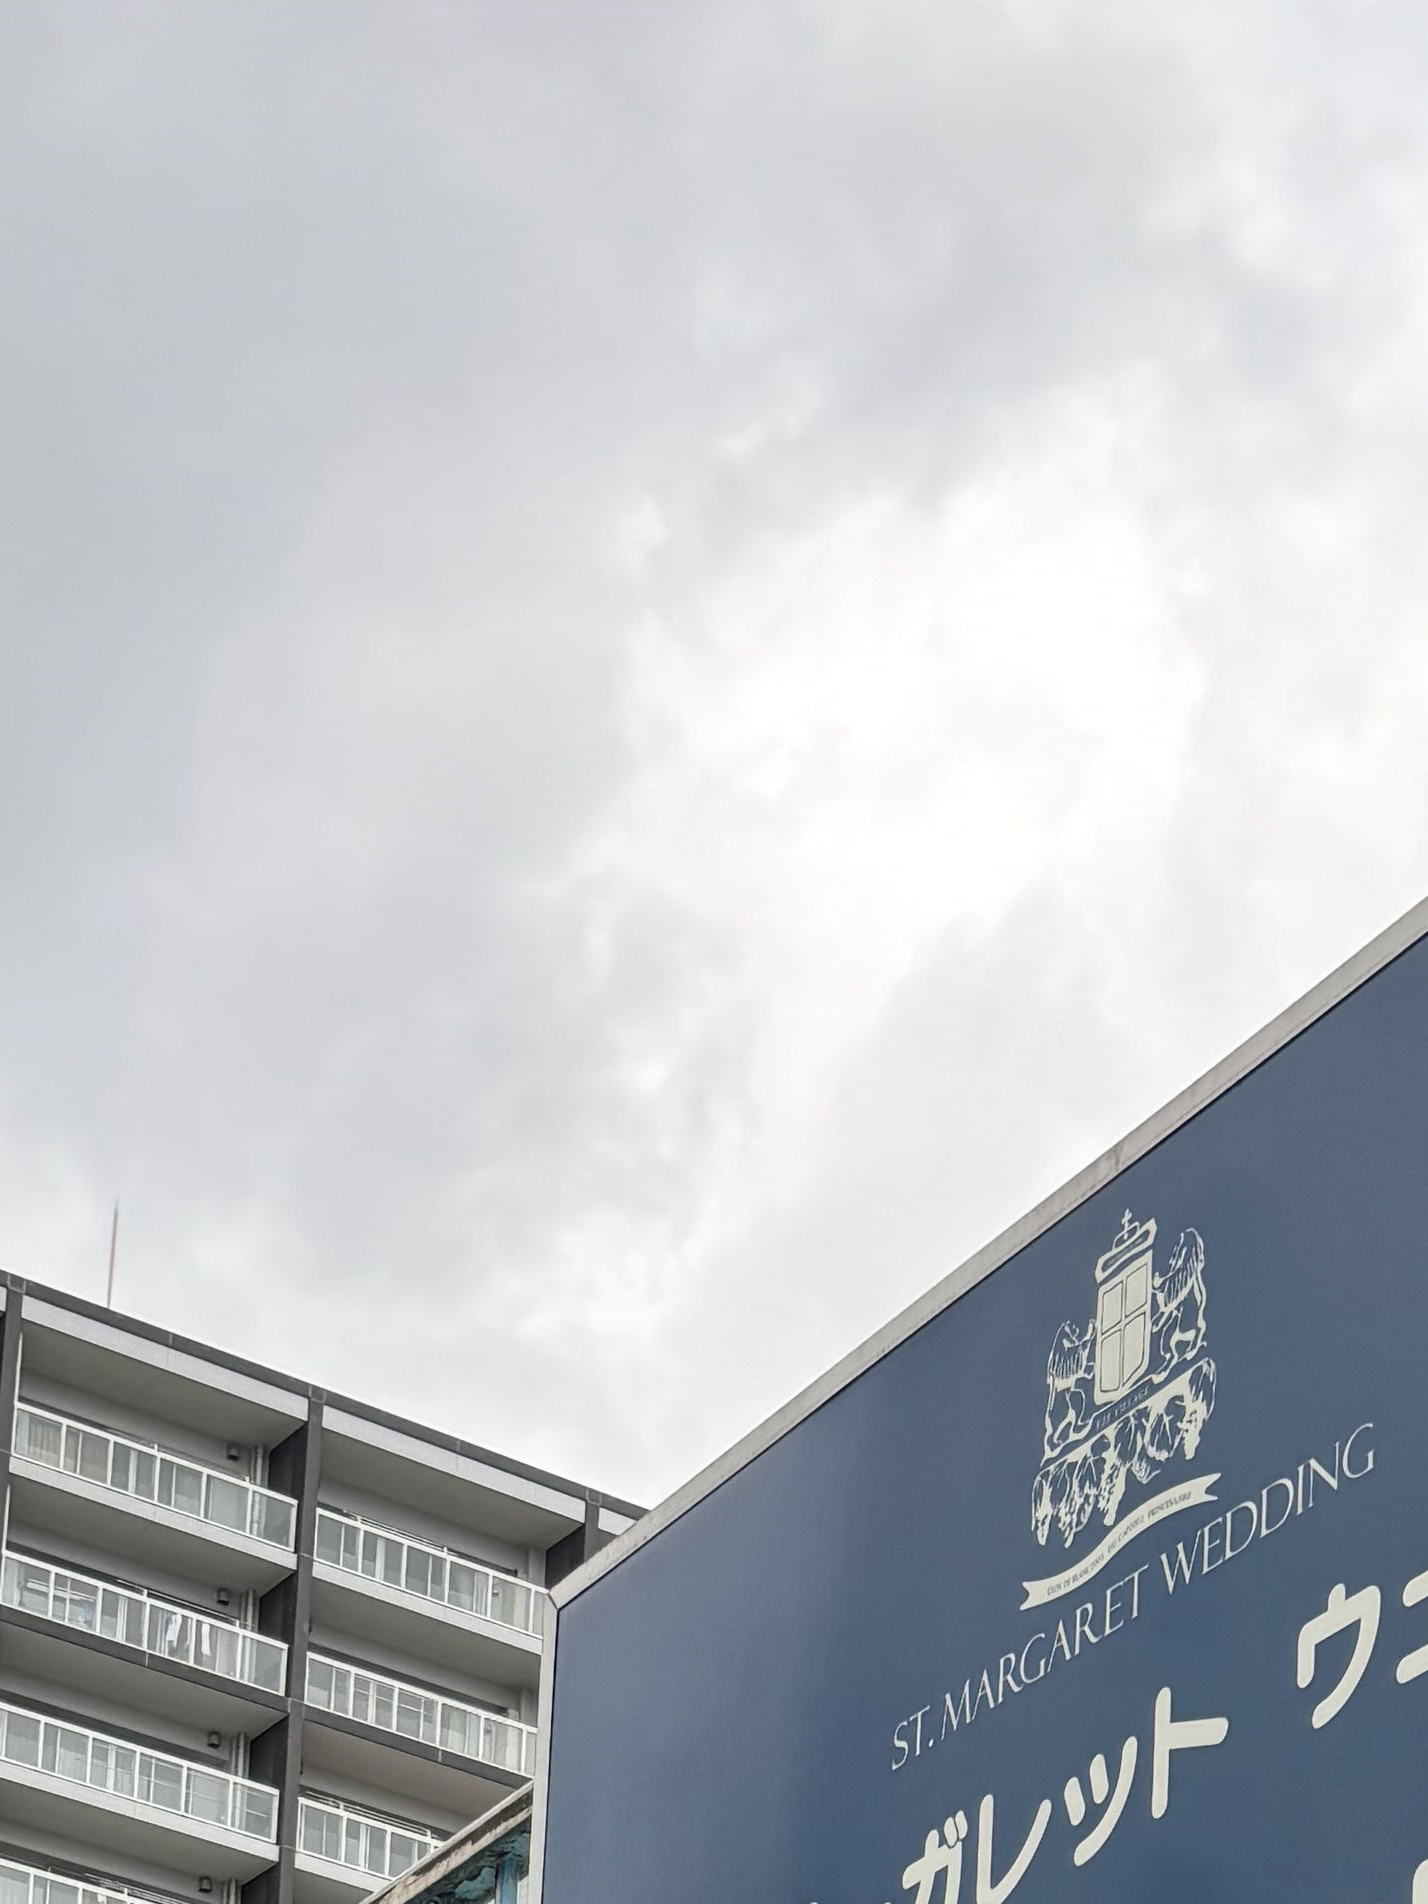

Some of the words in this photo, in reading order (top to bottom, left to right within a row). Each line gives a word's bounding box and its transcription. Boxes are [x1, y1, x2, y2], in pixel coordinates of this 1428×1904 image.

[892, 1706, 935, 1770] ST.
[940, 1564, 1150, 1742] MARGARET
[1160, 1423, 1375, 1594] WEDDING
